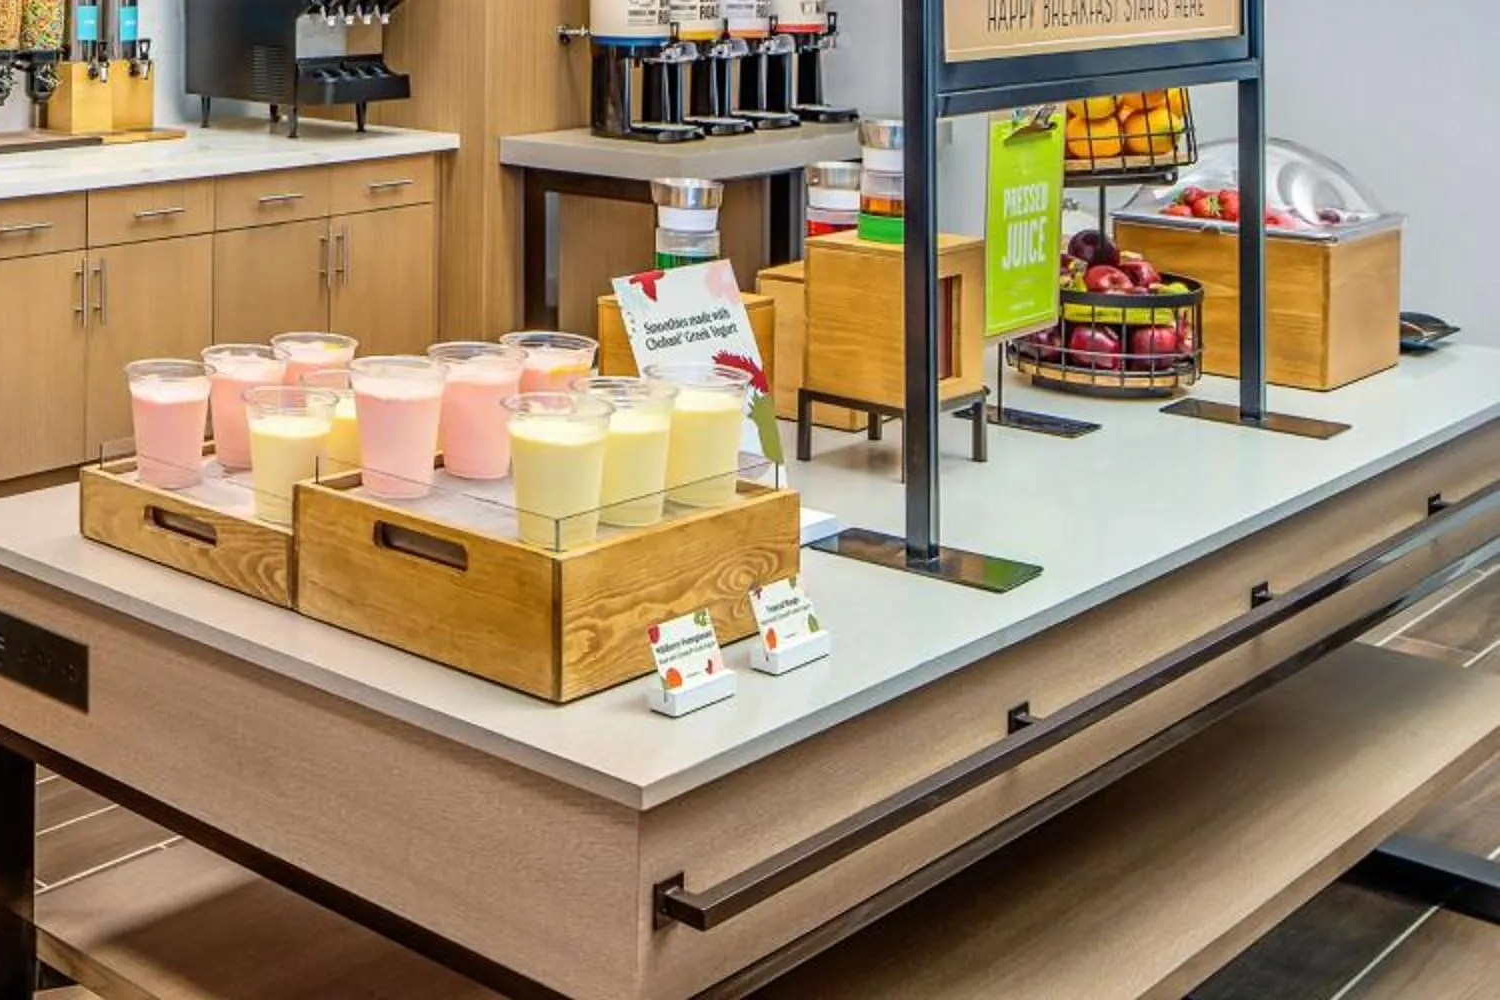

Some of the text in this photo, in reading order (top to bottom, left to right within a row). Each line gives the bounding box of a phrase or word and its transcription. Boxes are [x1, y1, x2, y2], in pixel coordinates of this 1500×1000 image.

[1004, 182, 1049, 223] PRESSED
[1002, 215, 1047, 270] JUICE
[643, 306, 731, 335] Smoothies made with
[684, 327, 711, 343] Greek
[710, 322, 739, 340] Yogurt
